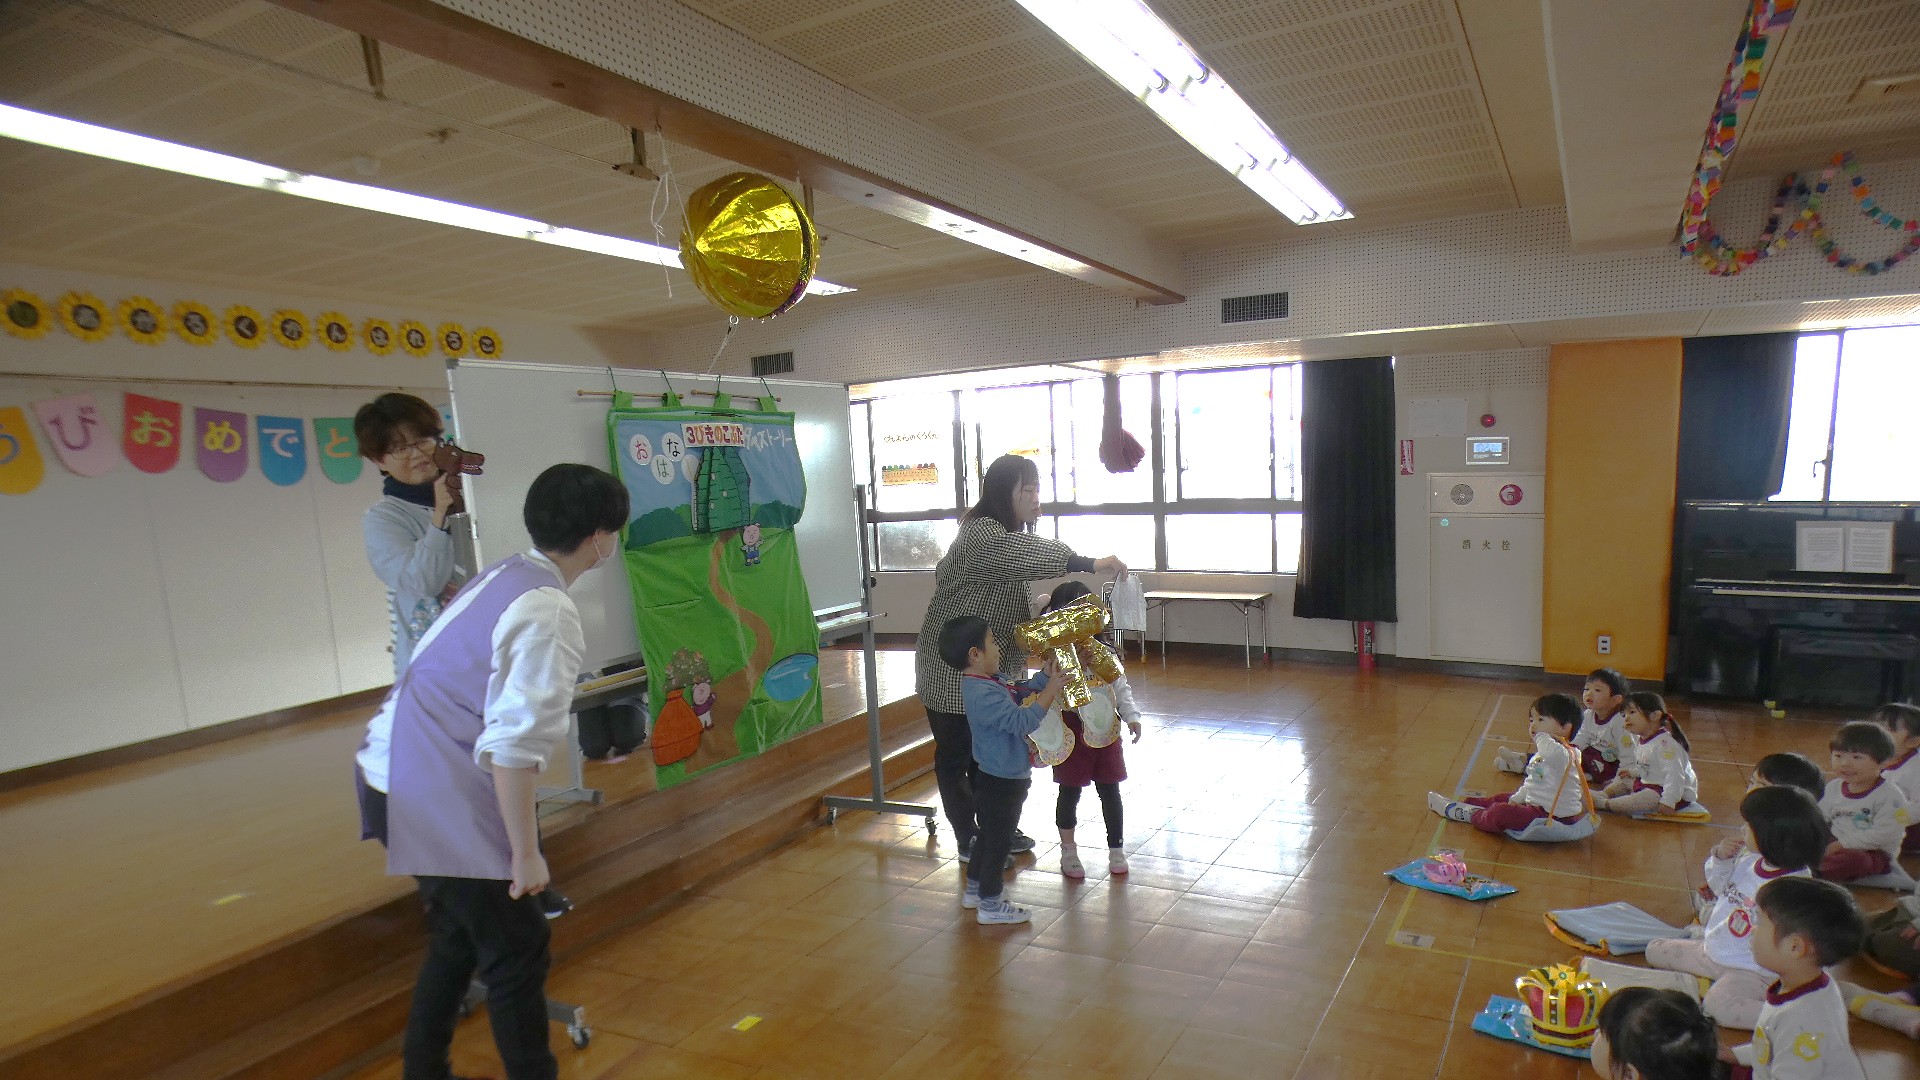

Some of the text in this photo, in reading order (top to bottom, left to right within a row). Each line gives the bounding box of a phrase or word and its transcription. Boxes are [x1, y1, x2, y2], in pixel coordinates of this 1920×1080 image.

[686, 425, 744, 444] 3びきのこぶた
[1462, 539, 1511, 551] 消火栓
